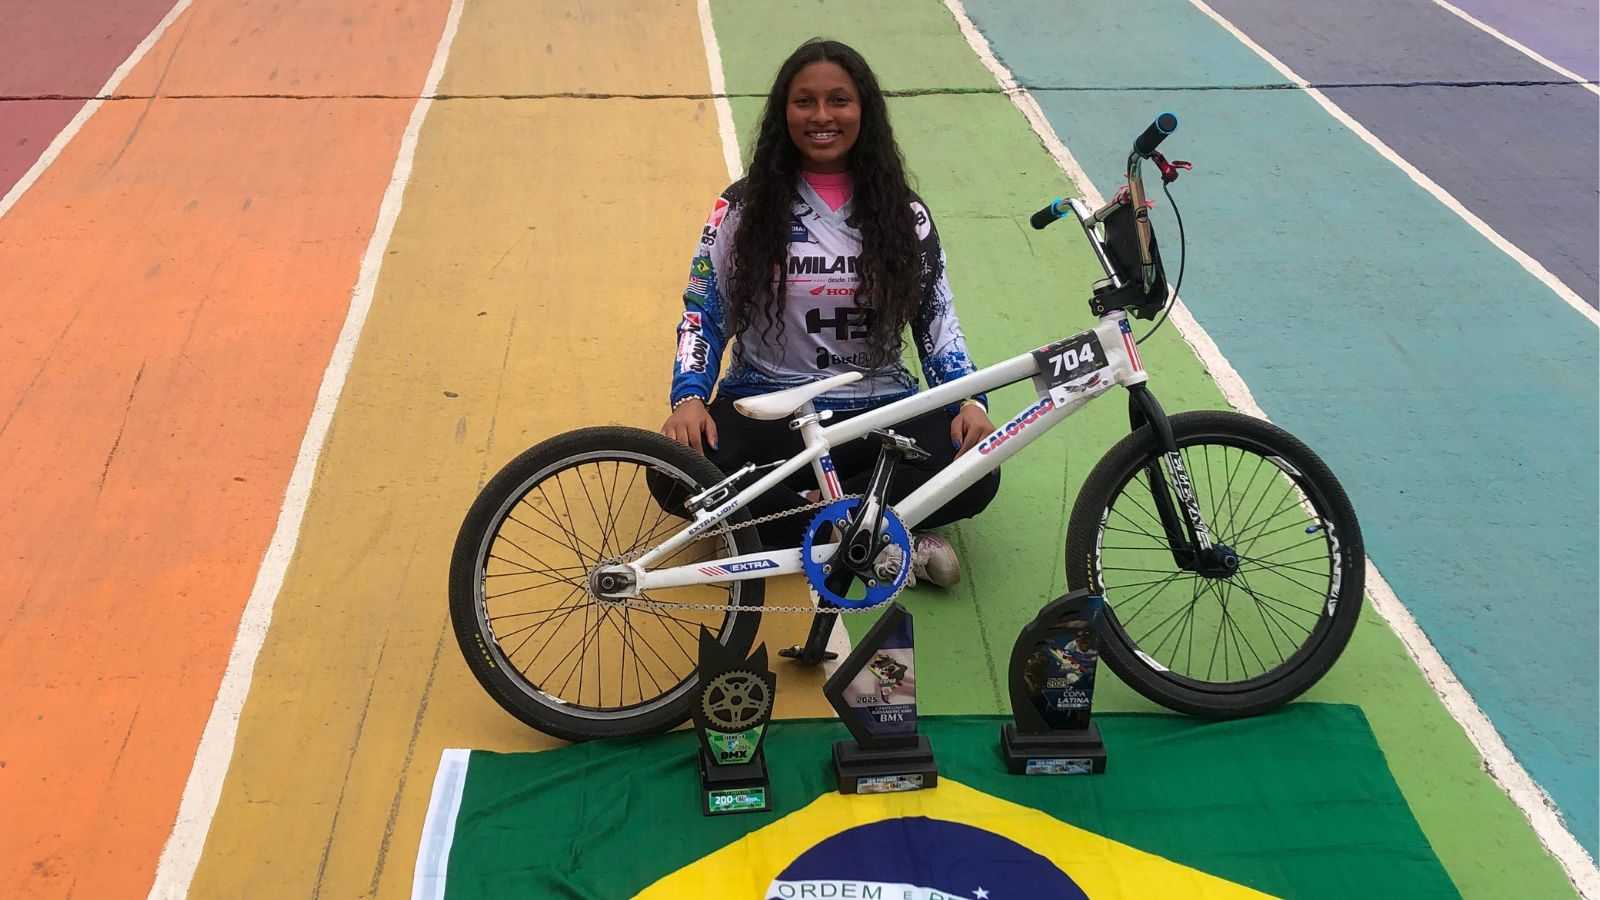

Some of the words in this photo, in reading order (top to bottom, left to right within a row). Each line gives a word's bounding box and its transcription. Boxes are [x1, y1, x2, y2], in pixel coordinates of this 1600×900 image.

[788, 255, 862, 274] MILAN
[826, 288, 858, 296] HON
[1048, 342, 1096, 377] 704
[688, 516, 716, 536] EXTRA
[717, 499, 739, 517] LIGHT
[732, 560, 771, 572] EXTRA
[880, 713, 903, 722] BMX
[720, 750, 747, 760] BMX
[715, 795, 733, 806] 200
[778, 883, 882, 900] ORDEM
